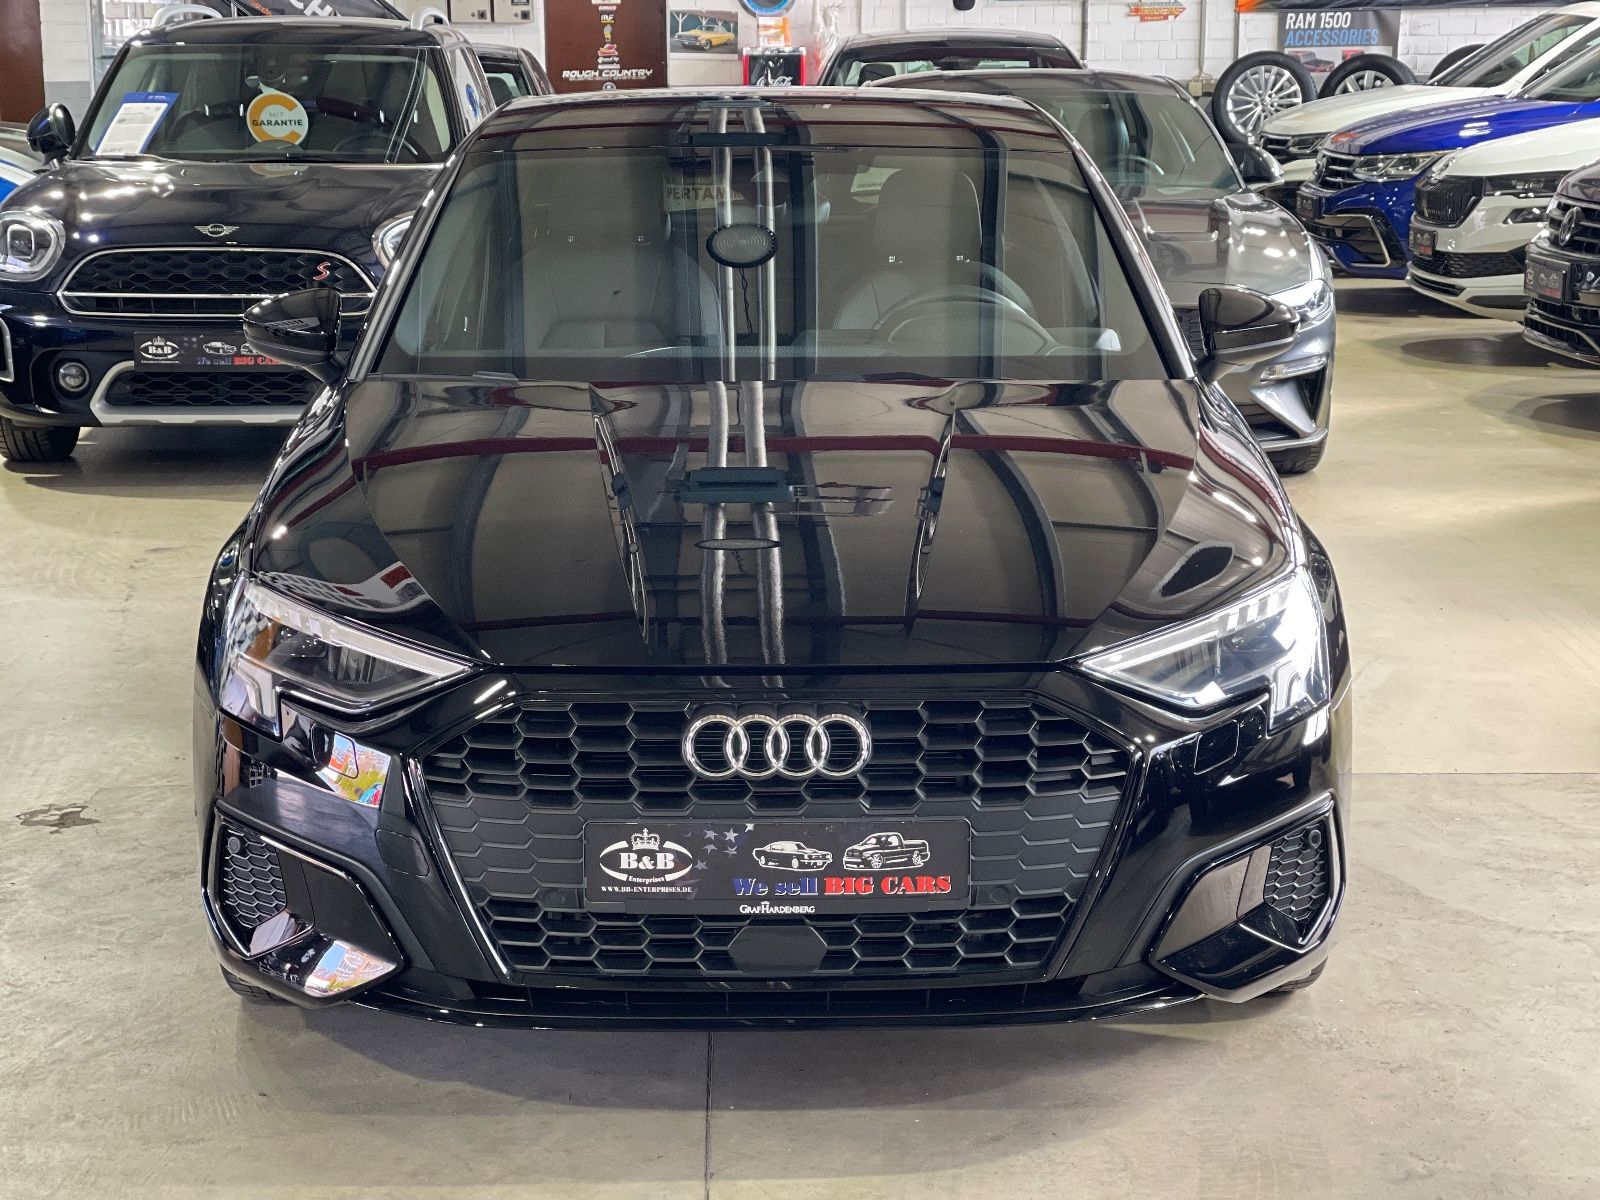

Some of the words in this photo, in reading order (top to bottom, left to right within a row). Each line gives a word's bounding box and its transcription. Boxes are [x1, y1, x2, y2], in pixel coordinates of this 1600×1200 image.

[1285, 12, 1316, 29] RAM
[1320, 11, 1352, 28] 1500
[1285, 28, 1379, 46] ACCESSORIES
[562, 69, 599, 78] ROUGH
[601, 68, 653, 77] COUNTRY
[313, 261, 331, 281] S
[618, 852, 675, 870] B&B
[628, 875, 665, 885] Enterprises
[732, 877, 768, 896] We
[774, 877, 818, 896] sell
[824, 876, 875, 896] BIG
[880, 874, 952, 895] CARS
